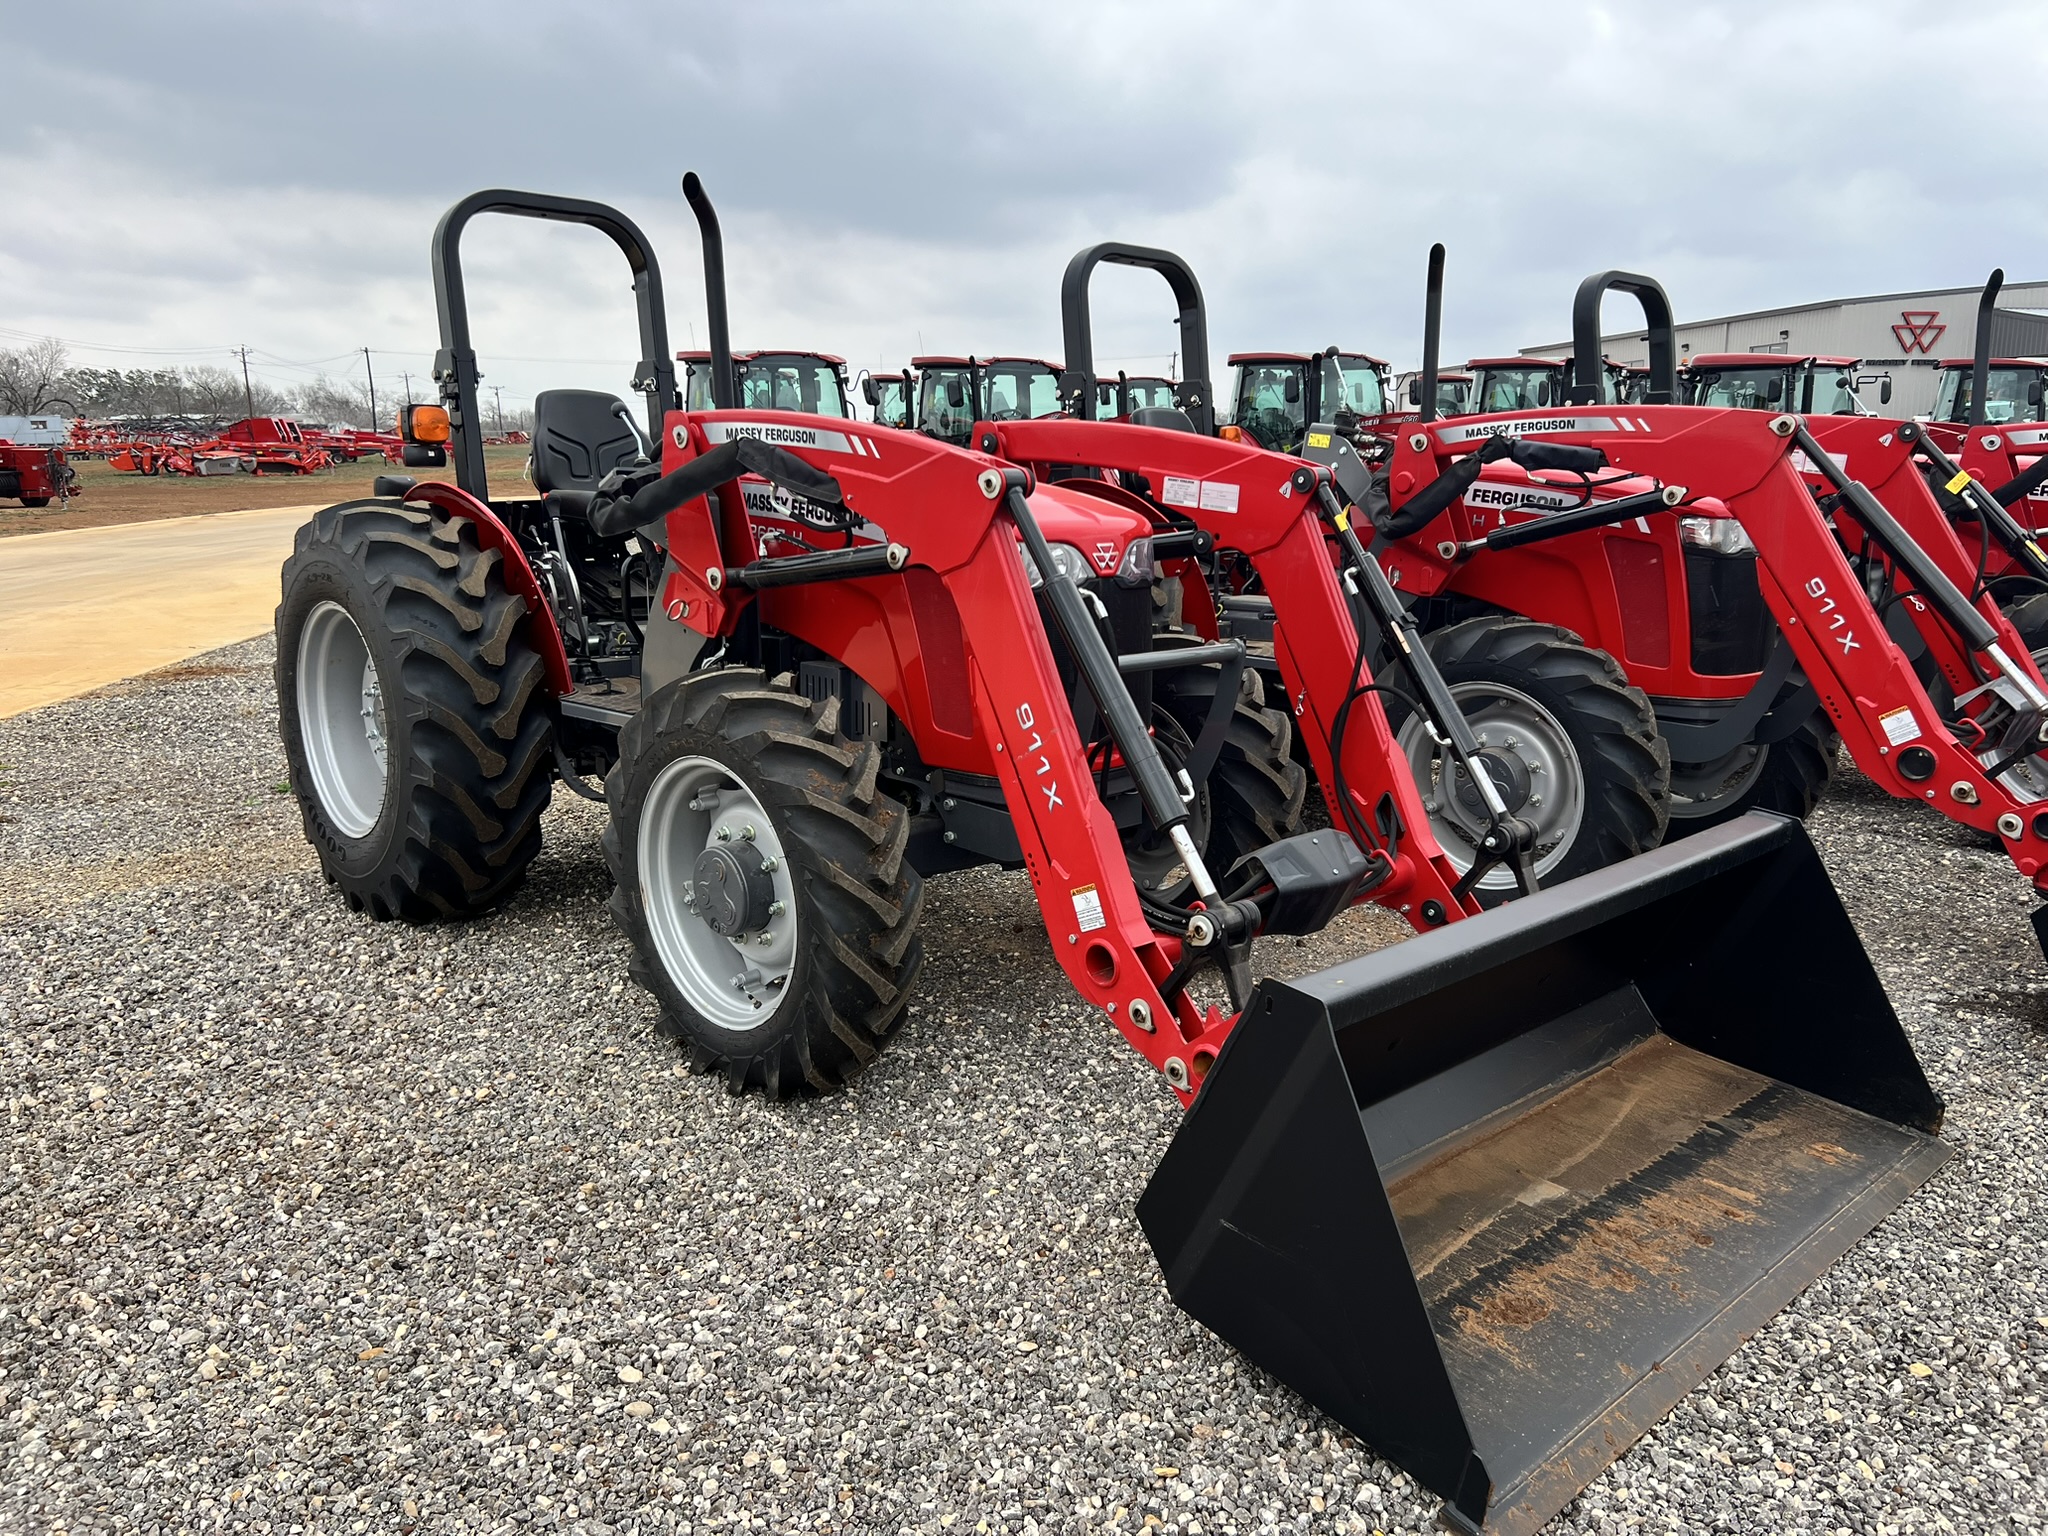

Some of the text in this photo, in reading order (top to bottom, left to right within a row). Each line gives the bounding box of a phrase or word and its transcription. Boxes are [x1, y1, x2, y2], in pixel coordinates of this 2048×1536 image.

[725, 427, 816, 445] MASSEY FERGUSON
[1465, 419, 1576, 439] MASSEY FERGUSON
[1471, 488, 1564, 507] FERGUSON
[1472, 514, 1485, 527] H
[1805, 576, 1862, 656] 911X
[1015, 702, 1065, 814] 911X
